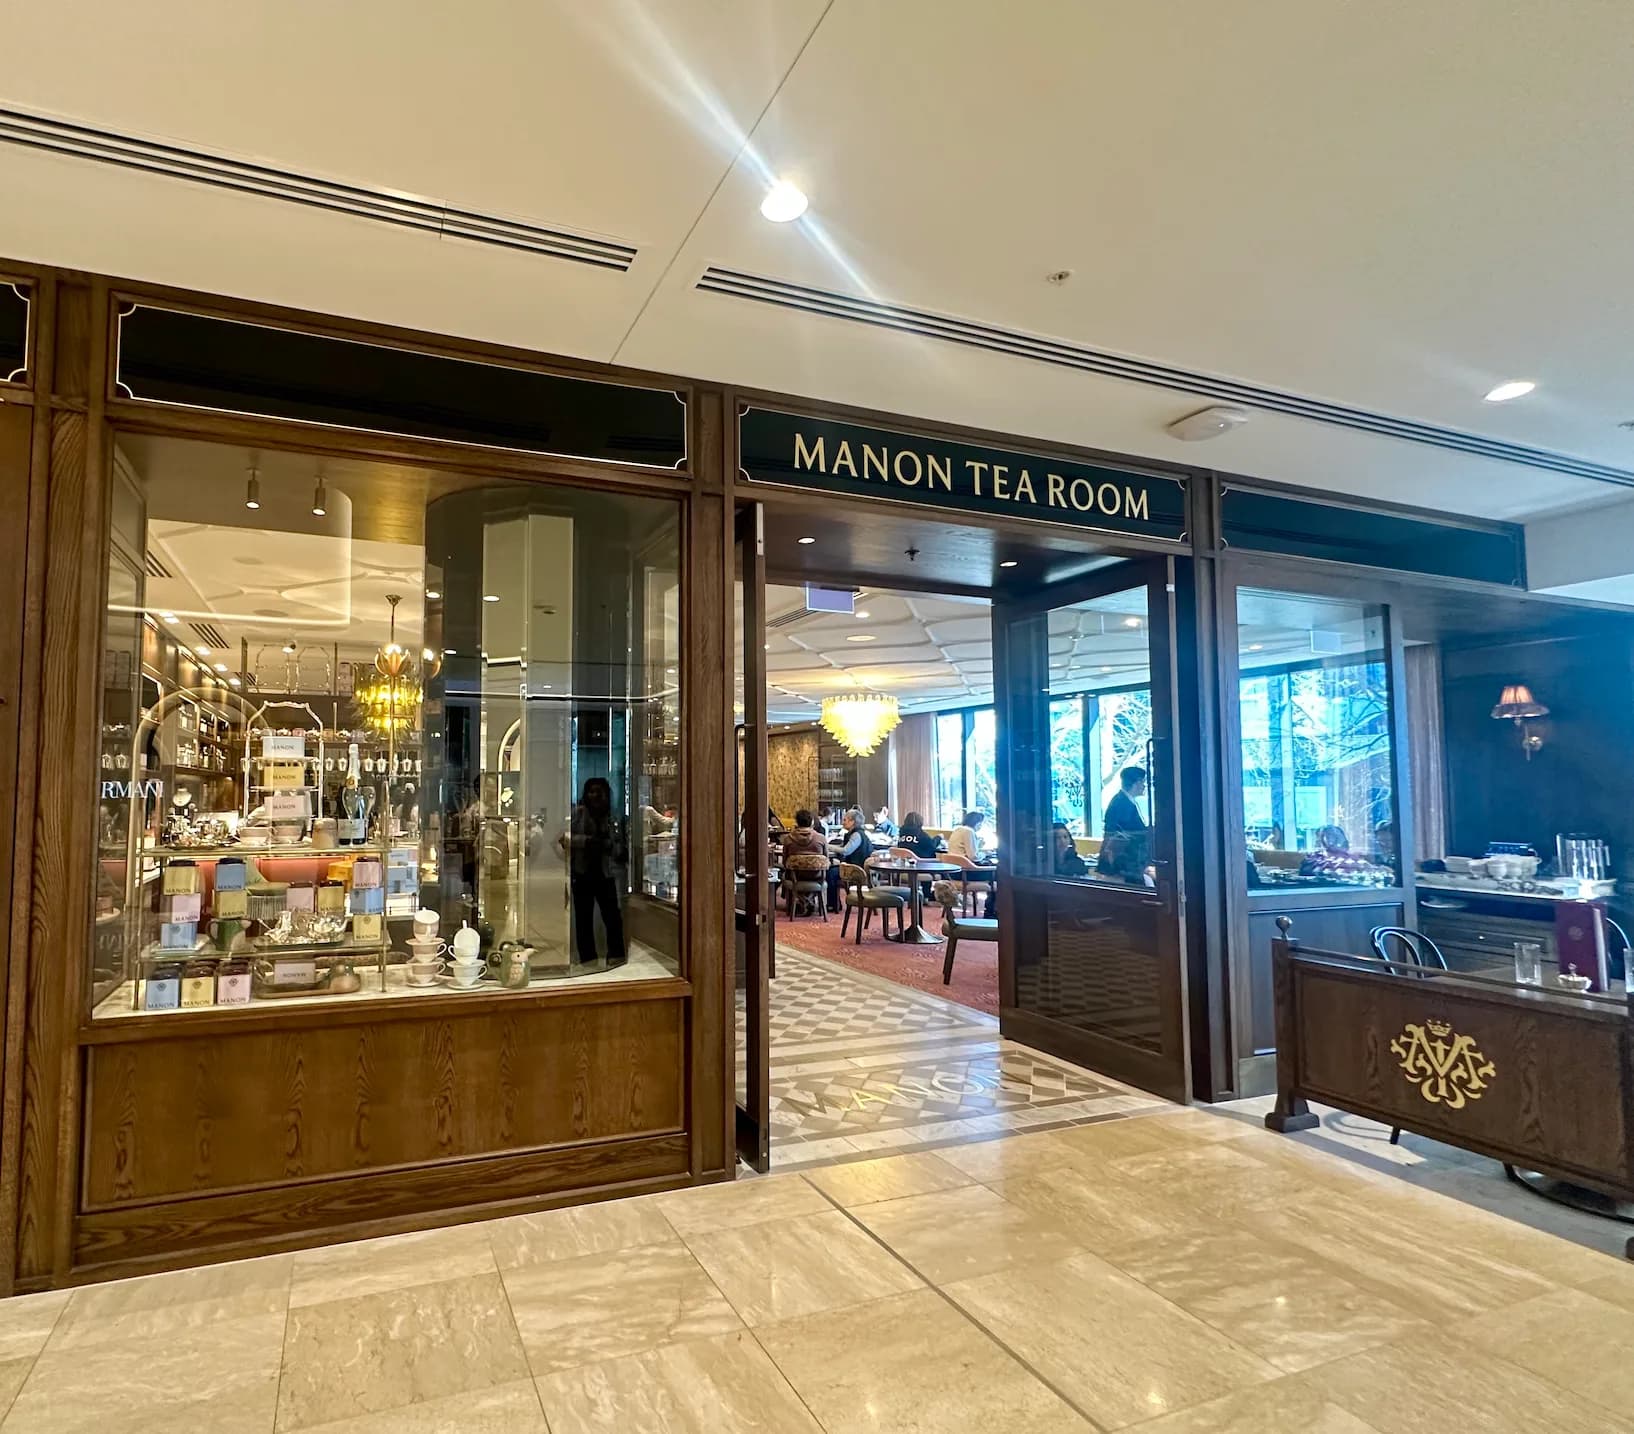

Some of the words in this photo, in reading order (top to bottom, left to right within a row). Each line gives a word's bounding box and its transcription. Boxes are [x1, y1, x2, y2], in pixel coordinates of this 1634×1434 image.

[793, 432, 951, 491] MANON
[965, 460, 1037, 503] TEA
[1047, 473, 1149, 520] ROOM
[183, 999, 210, 1007] MANON
[780, 1069, 1035, 1117] MANON
